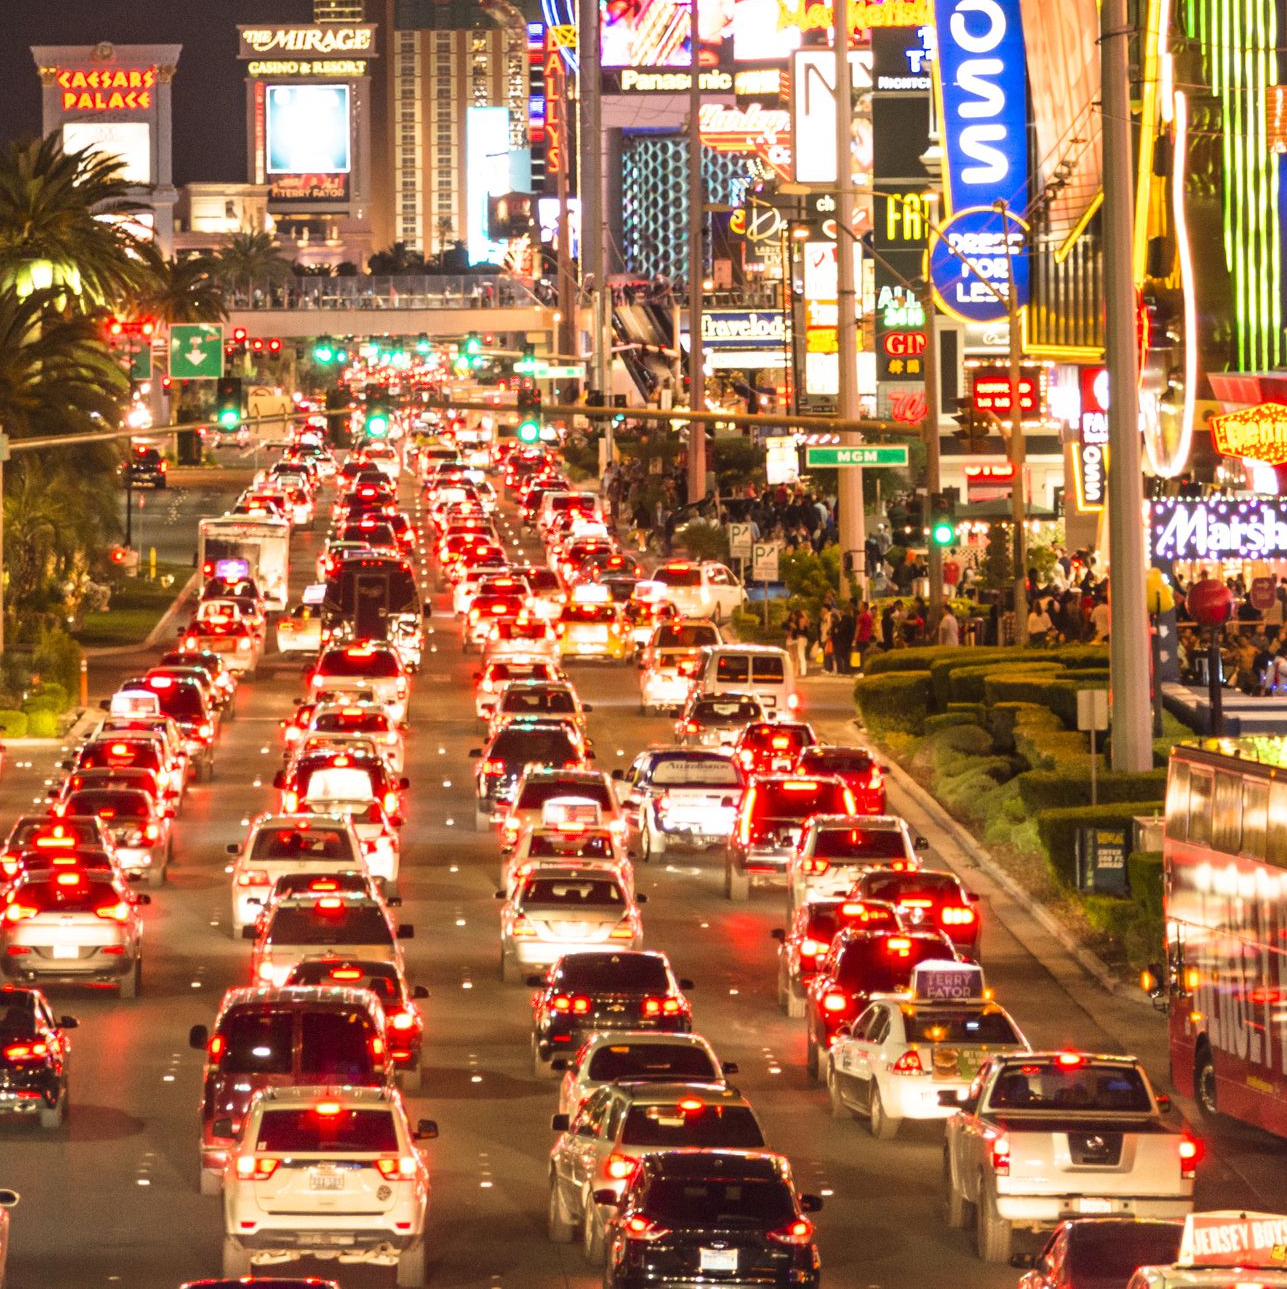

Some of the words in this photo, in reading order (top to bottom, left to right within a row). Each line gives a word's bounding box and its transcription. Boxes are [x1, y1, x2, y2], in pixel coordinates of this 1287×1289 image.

[263, 28, 372, 52] MIRAGE
[248, 60, 297, 75] CASINO
[300, 61, 311, 74] &
[312, 60, 366, 75] RESORT
[58, 71, 156, 90] CAESARS
[621, 69, 733, 92] Panasnic
[62, 92, 151, 110] PALACE
[948, 233, 1025, 255] DRESS
[961, 258, 1010, 279] FOR
[700, 314, 788, 341] Travelod
[926, 974, 973, 986] TERRY
[927, 986, 972, 998] FATOR
[1192, 1223, 1249, 1256] JERSEY
